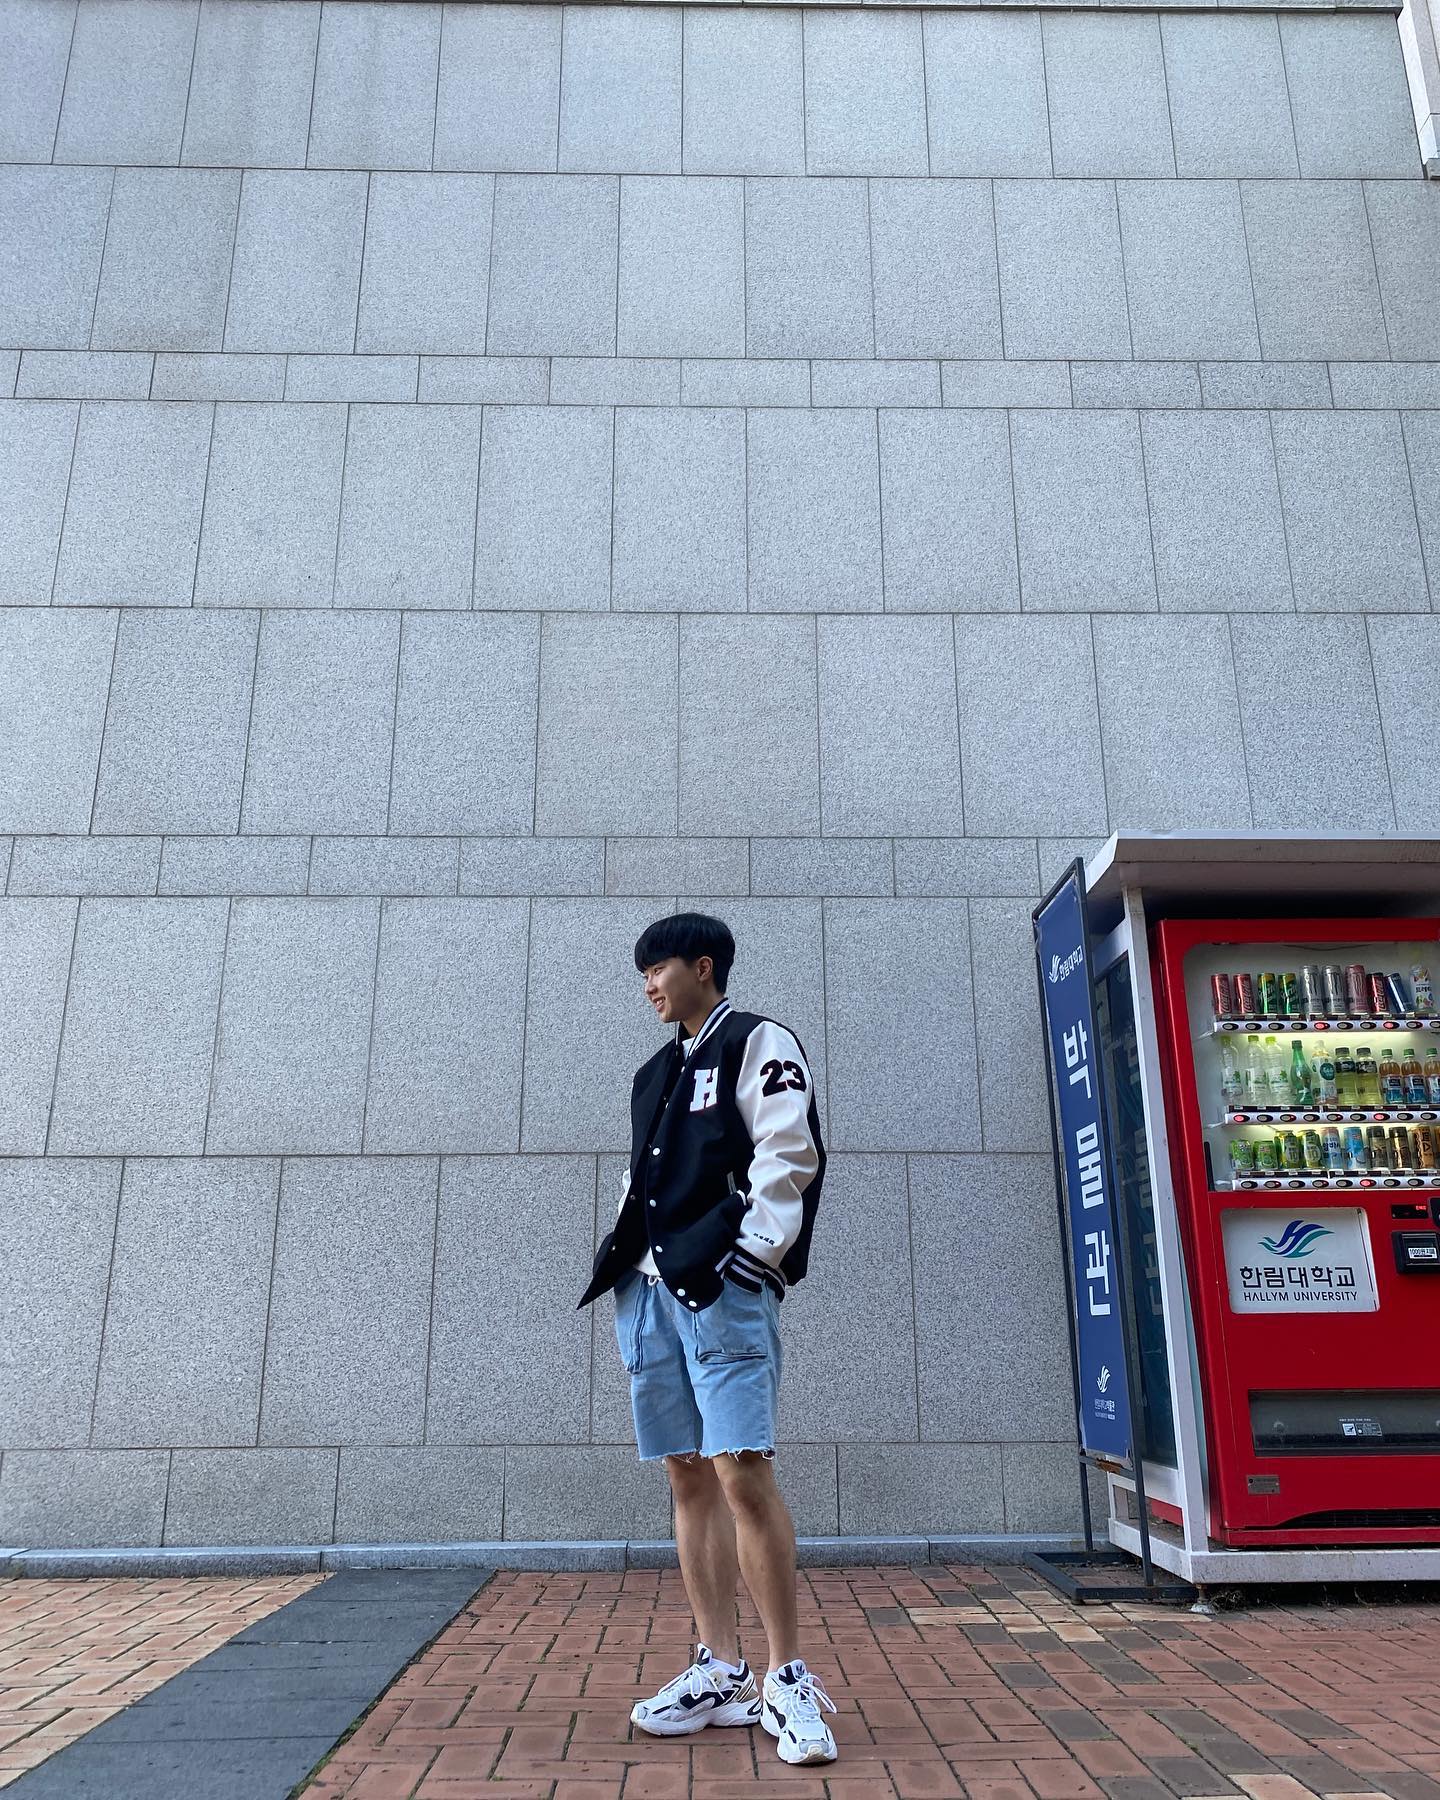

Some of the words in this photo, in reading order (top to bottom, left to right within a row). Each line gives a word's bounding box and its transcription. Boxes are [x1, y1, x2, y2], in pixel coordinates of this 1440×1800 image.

[689, 1065, 719, 1112] H
[759, 1059, 807, 1098] 23
[1063, 1019, 1110, 1316] 박물관
[1240, 1266, 1356, 1288] 한림대학교
[1244, 1291, 1289, 1301] HALLYM
[1293, 1291, 1358, 1301] UNIVERSITY
